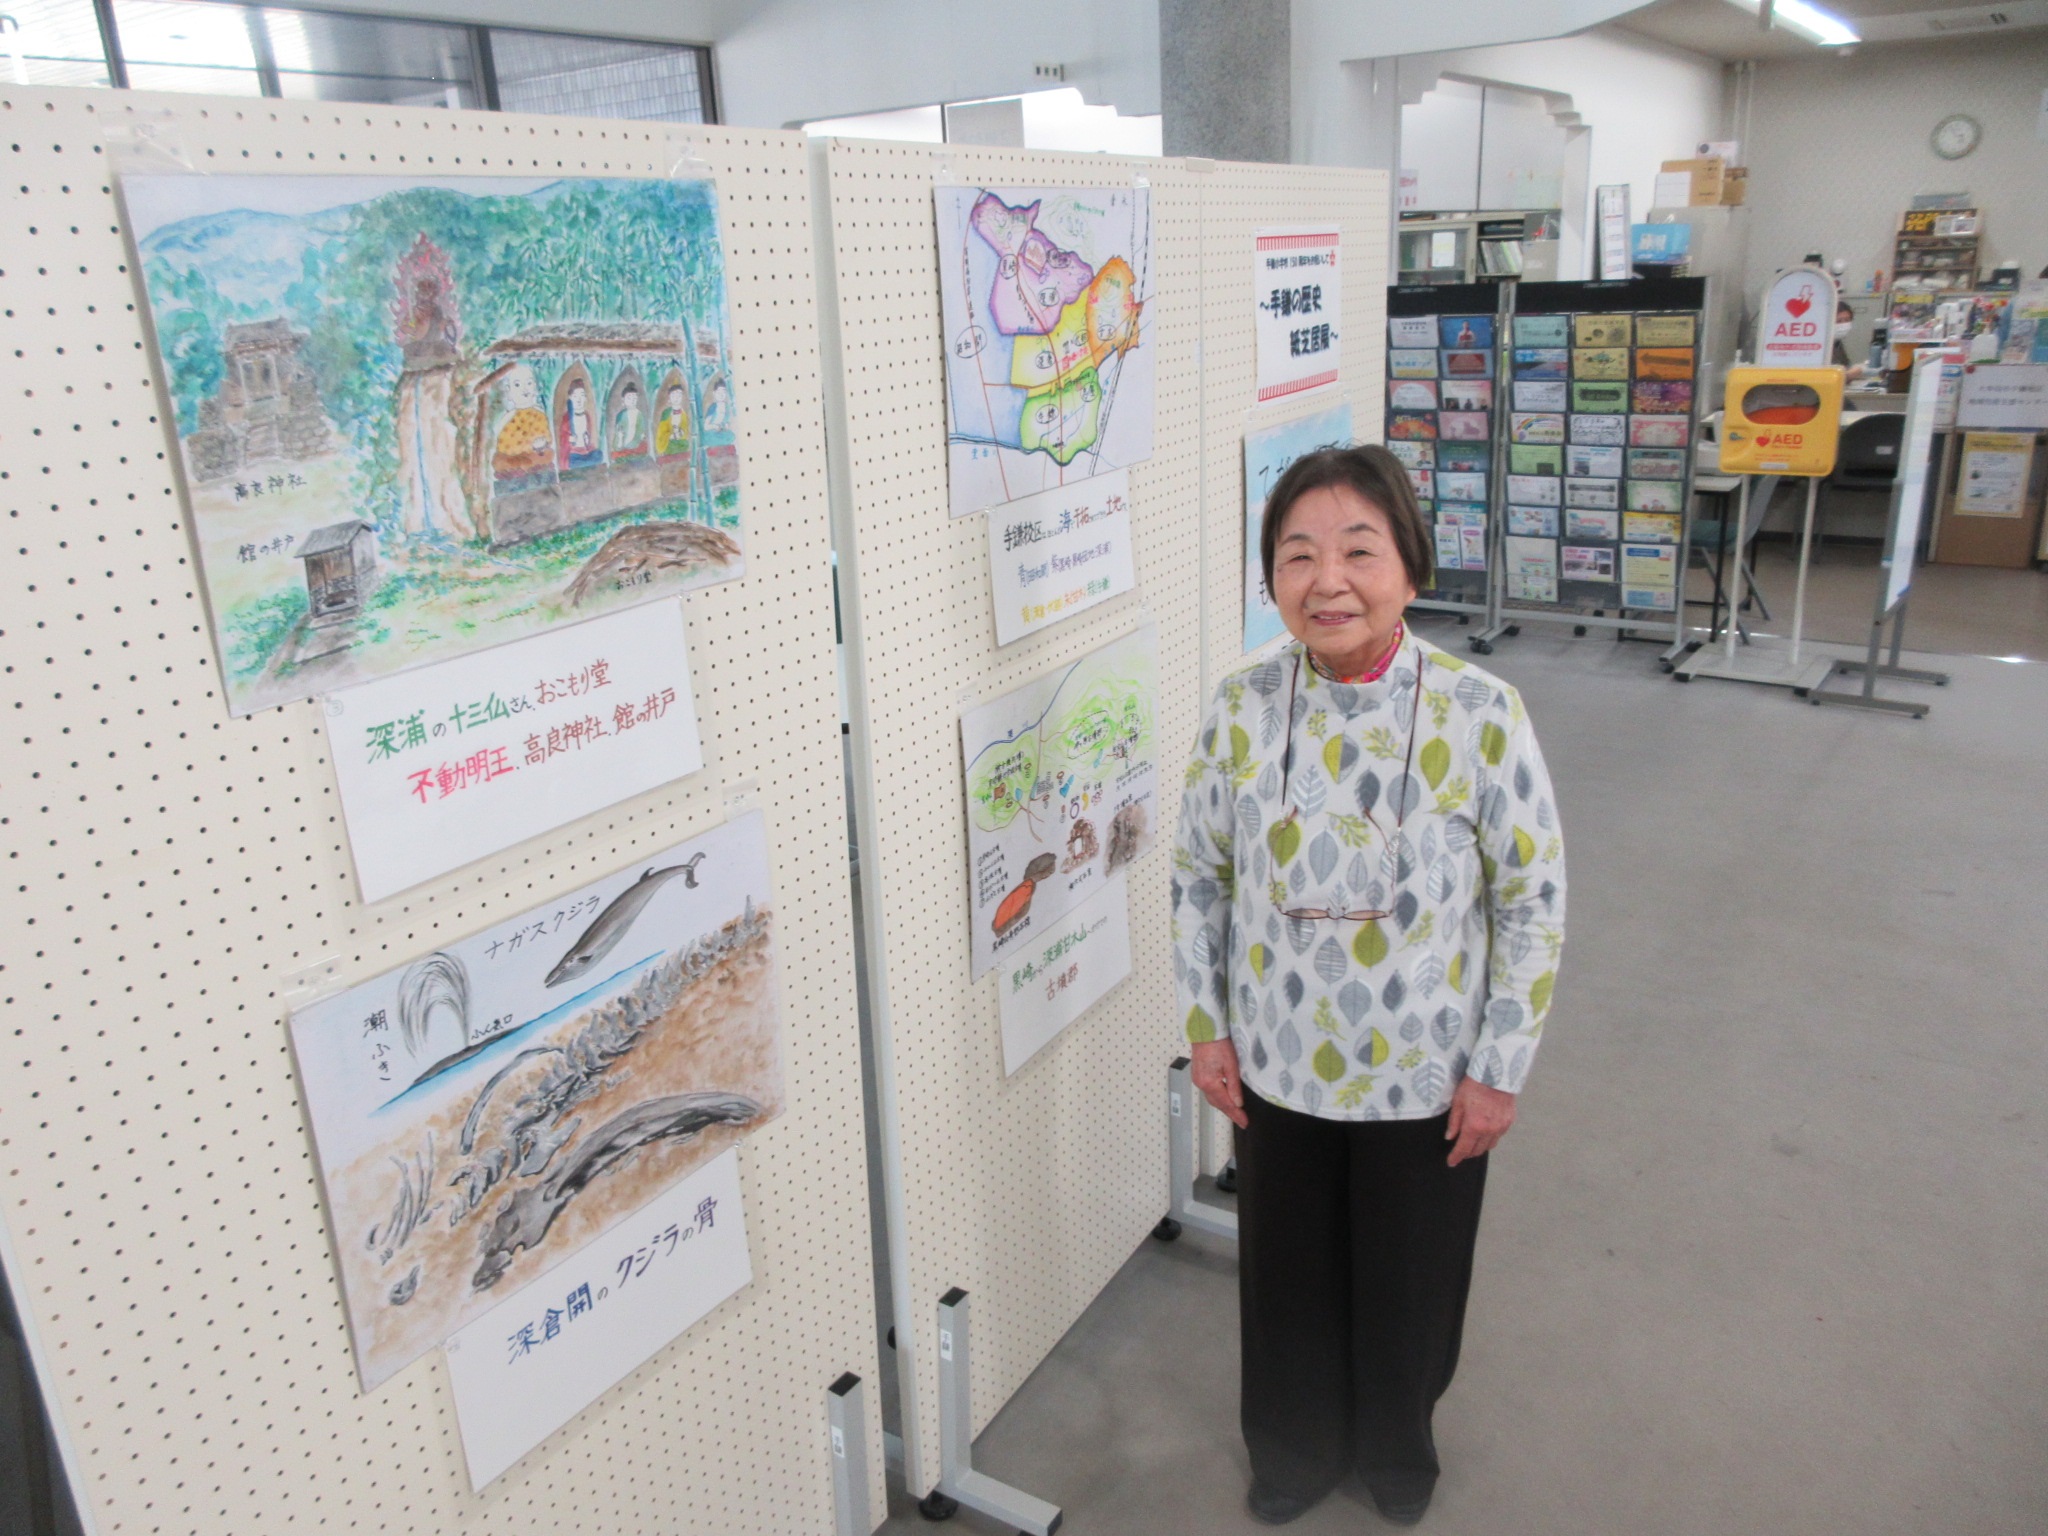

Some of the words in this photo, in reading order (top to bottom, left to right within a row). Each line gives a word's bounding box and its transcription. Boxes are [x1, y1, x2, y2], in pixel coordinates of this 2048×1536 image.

[1775, 322, 1817, 337] AED
[1772, 433, 1803, 446] AED
[234, 473, 307, 501] 高良神社
[484, 895, 601, 960] ナガスクジラ
[362, 1008, 391, 1082] 潮ふき
[507, 1196, 719, 1365] 深倉開のクジラの骨
